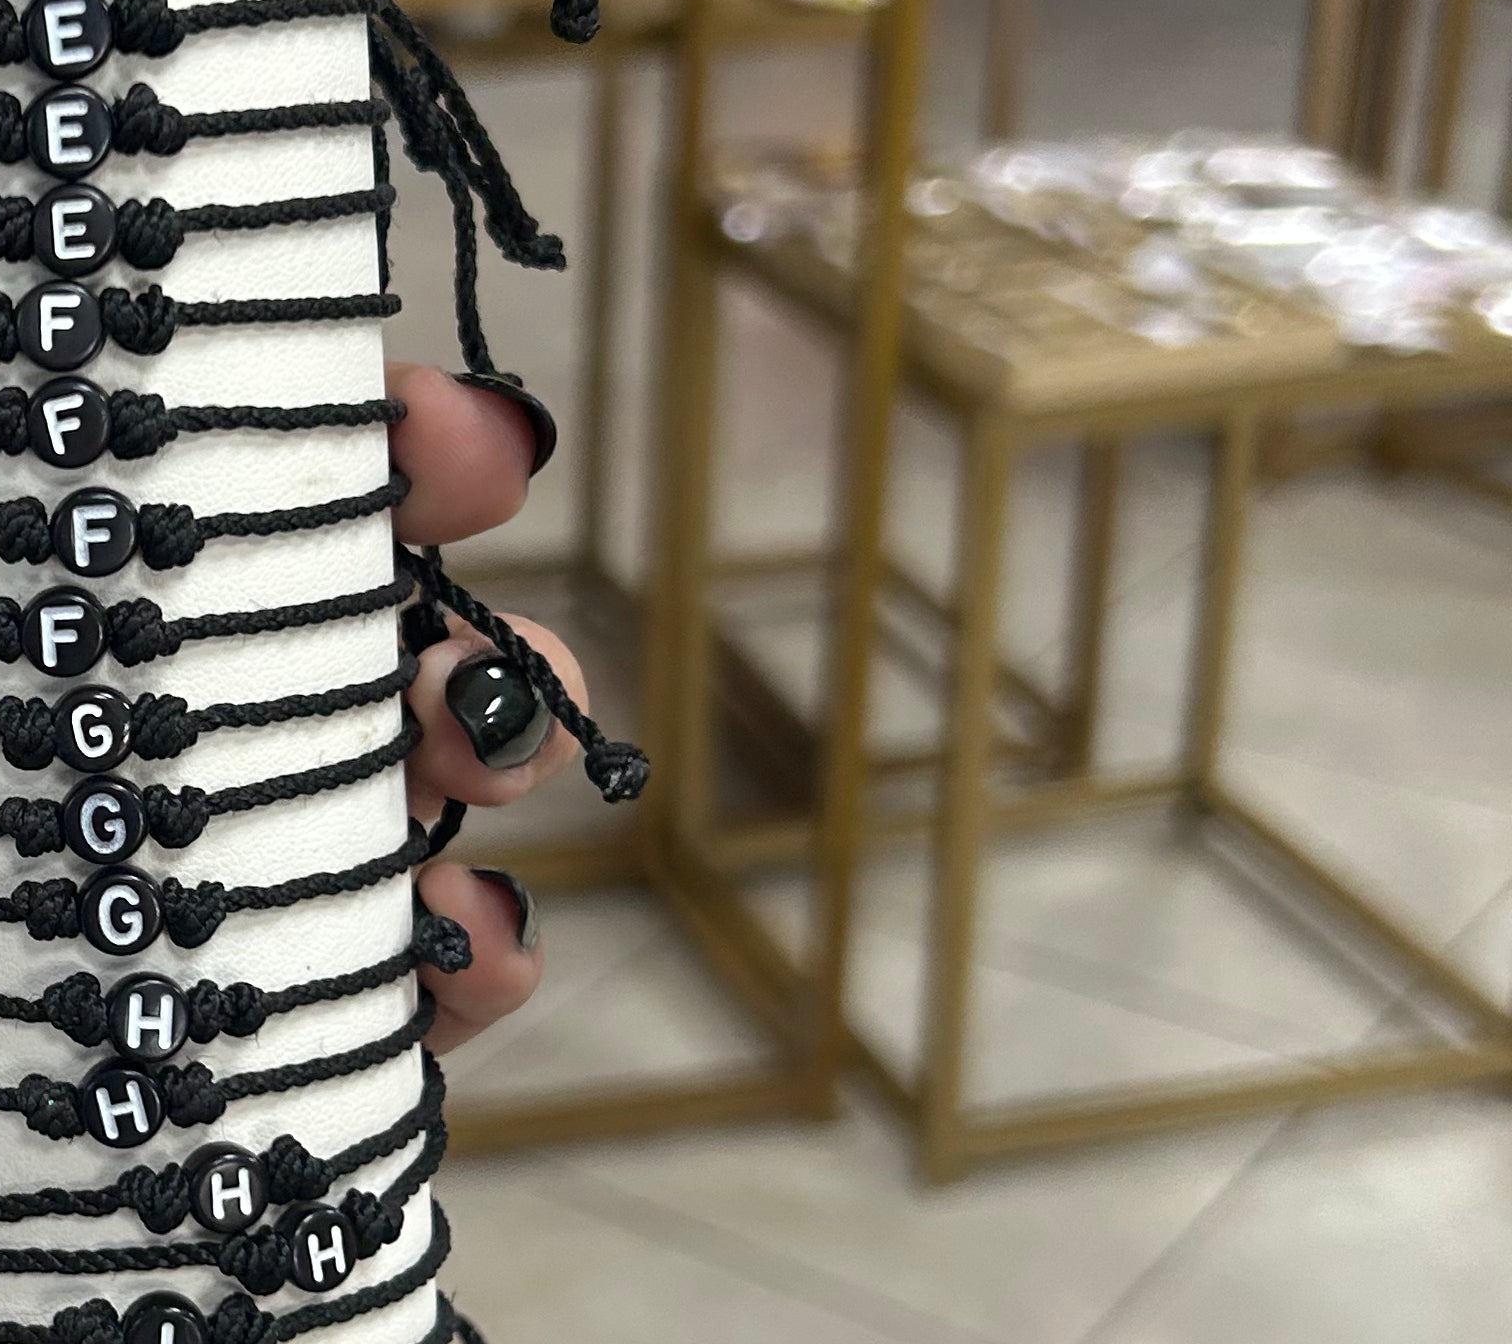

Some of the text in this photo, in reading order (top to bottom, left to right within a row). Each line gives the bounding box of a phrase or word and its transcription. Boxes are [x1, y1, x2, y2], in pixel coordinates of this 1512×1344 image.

[44, 0, 93, 66] E
[45, 101, 93, 164] E
[51, 200, 95, 259] E
[40, 294, 81, 351] F
[43, 395, 83, 454] F
[72, 505, 117, 567] F
[40, 606, 84, 667] F
[72, 703, 113, 758] G
[80, 793, 126, 854] G
[98, 885, 143, 946] G
[127, 994, 173, 1049] H
[96, 1081, 149, 1139] H
[211, 1168, 252, 1220] H
[308, 1225, 346, 1282] H
